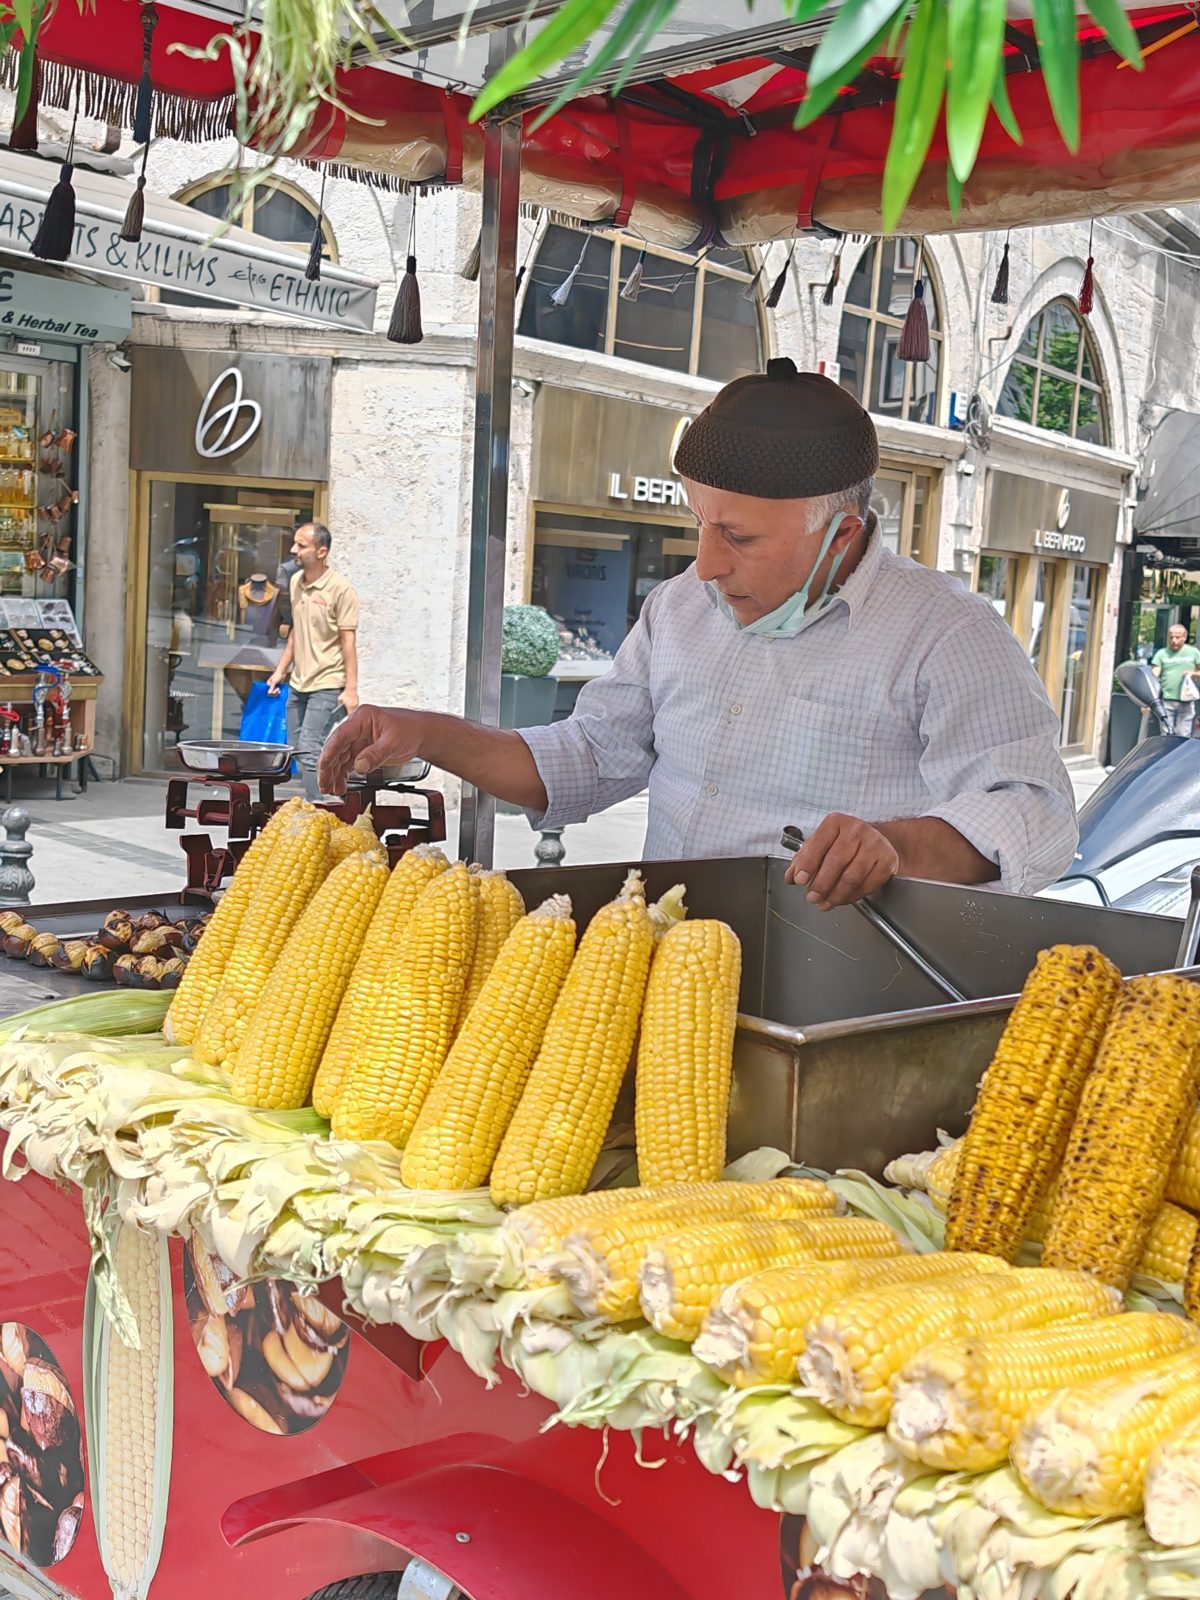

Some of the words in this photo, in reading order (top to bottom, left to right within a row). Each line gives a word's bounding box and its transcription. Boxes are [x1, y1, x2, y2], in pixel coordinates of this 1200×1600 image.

[0, 202, 99, 258] ARTS
[106, 232, 128, 268] &
[135, 242, 219, 287] KILIMS
[269, 273, 350, 317] ETHNIC
[1, 310, 15, 324] &
[17, 313, 71, 334] Herbal
[73, 323, 99, 338] Tea
[610, 472, 628, 499] IL
